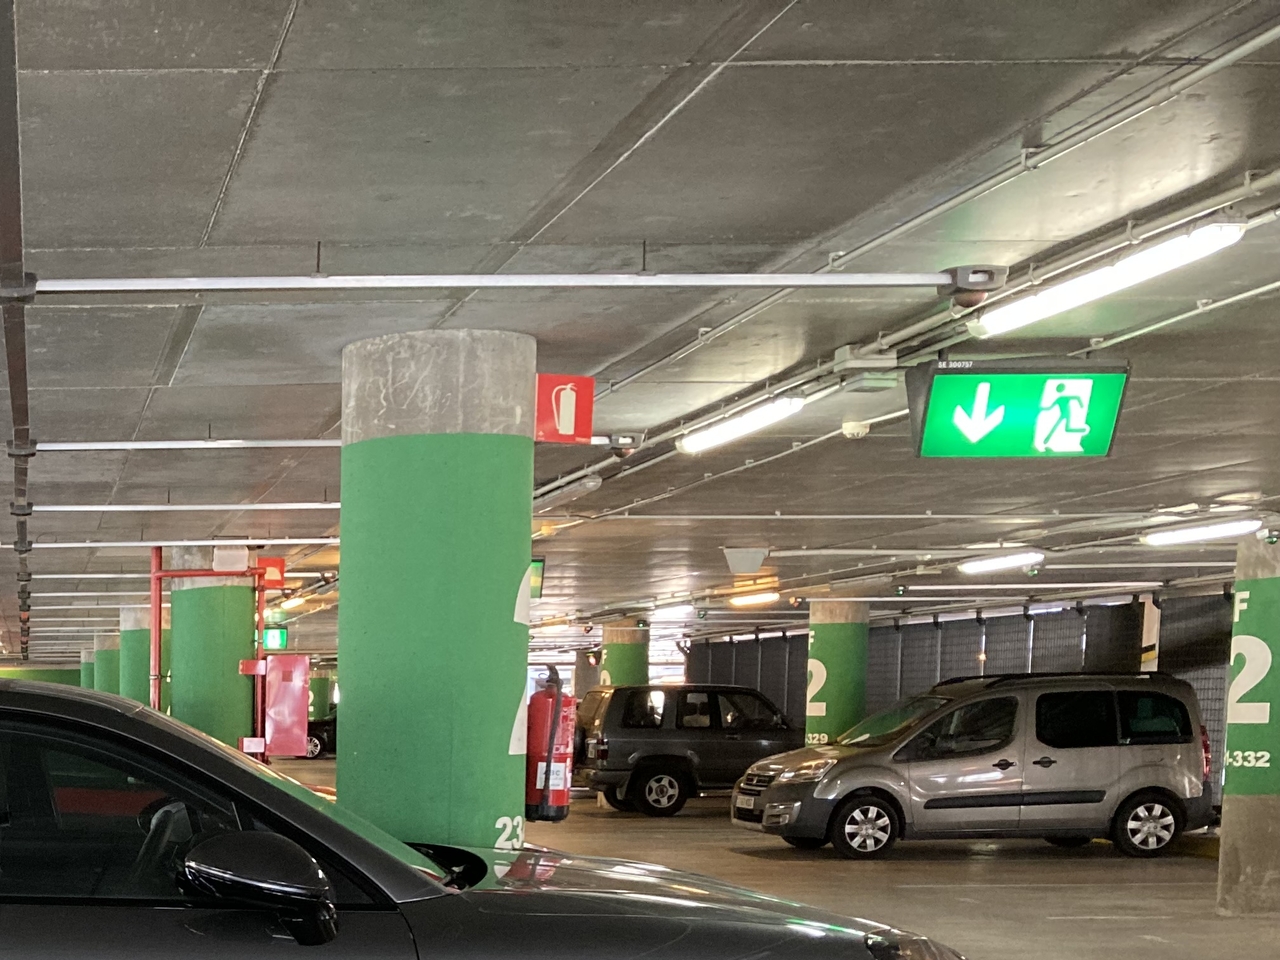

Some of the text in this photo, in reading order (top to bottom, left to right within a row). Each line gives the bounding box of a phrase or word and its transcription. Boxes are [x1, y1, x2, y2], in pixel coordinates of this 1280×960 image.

[1233, 591, 1250, 622] F
[806, 658, 827, 716] 2
[1226, 635, 1272, 723] 2
